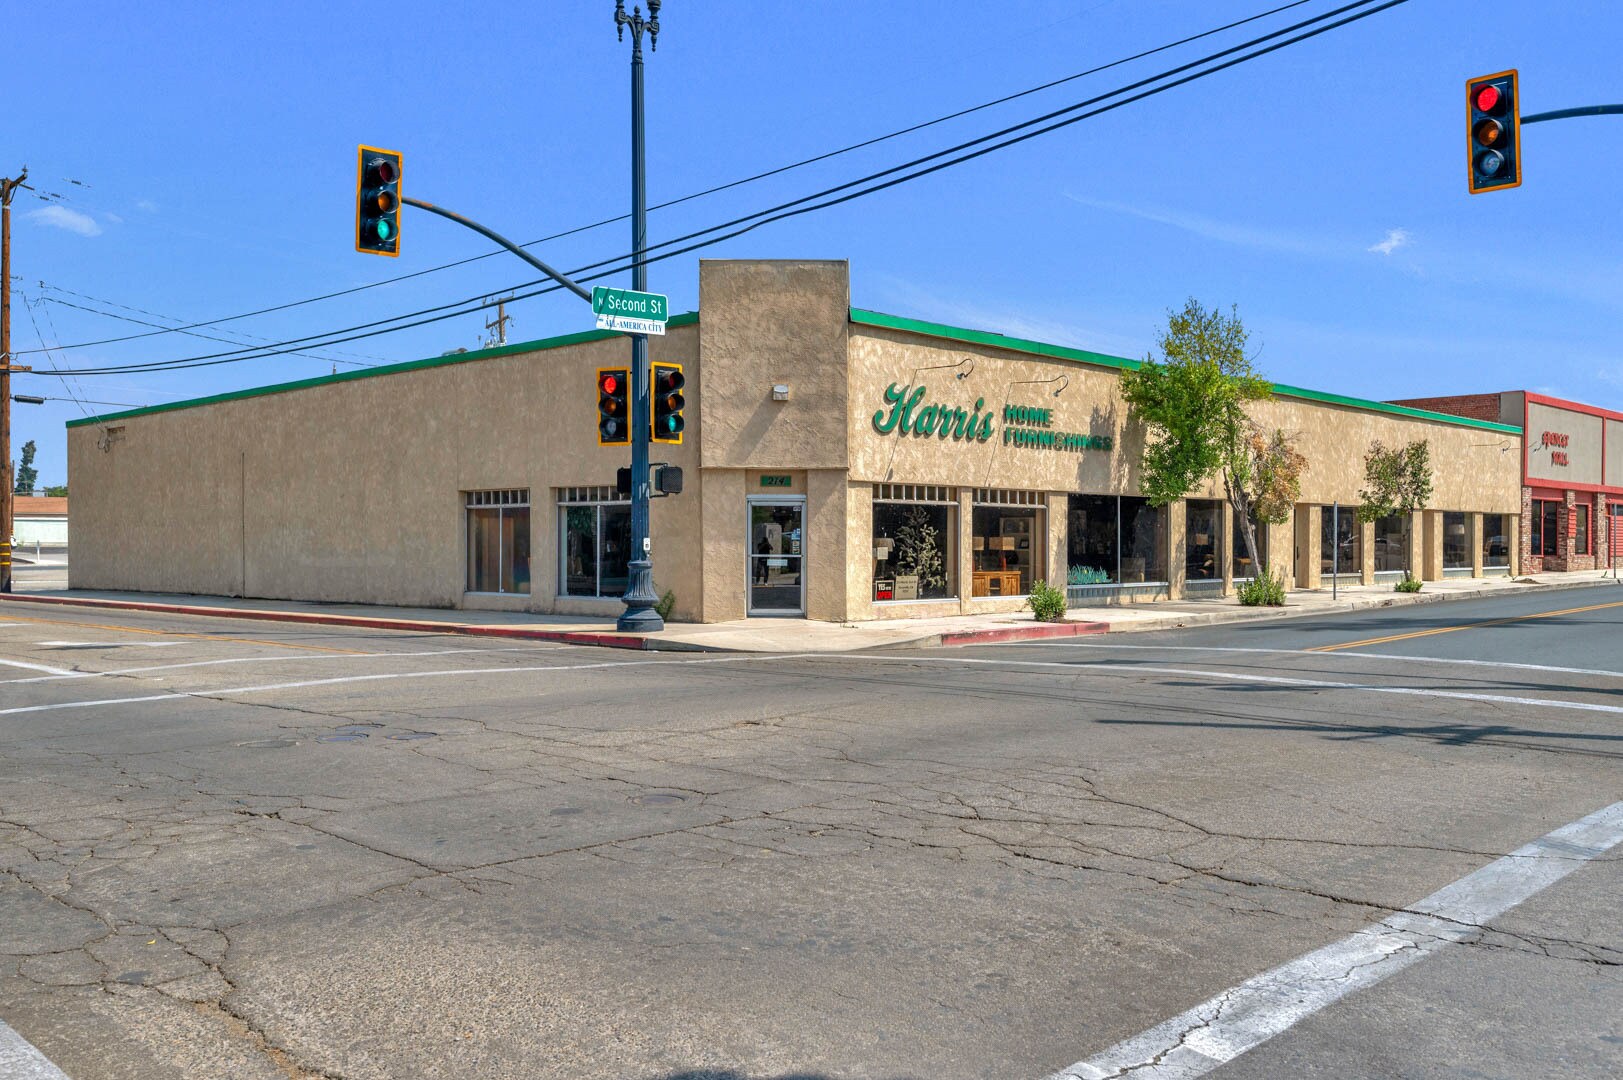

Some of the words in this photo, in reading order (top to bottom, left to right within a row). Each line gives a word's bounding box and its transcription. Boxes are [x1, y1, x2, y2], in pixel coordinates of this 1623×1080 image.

[608, 295, 646, 312] Second
[650, 300, 662, 314] St
[604, 319, 647, 330] ALL-AMERICA
[648, 322, 662, 332] CITY
[873, 381, 994, 442] Harris
[1004, 404, 1054, 425] HOME
[1004, 427, 1113, 451] FURNISHINGS
